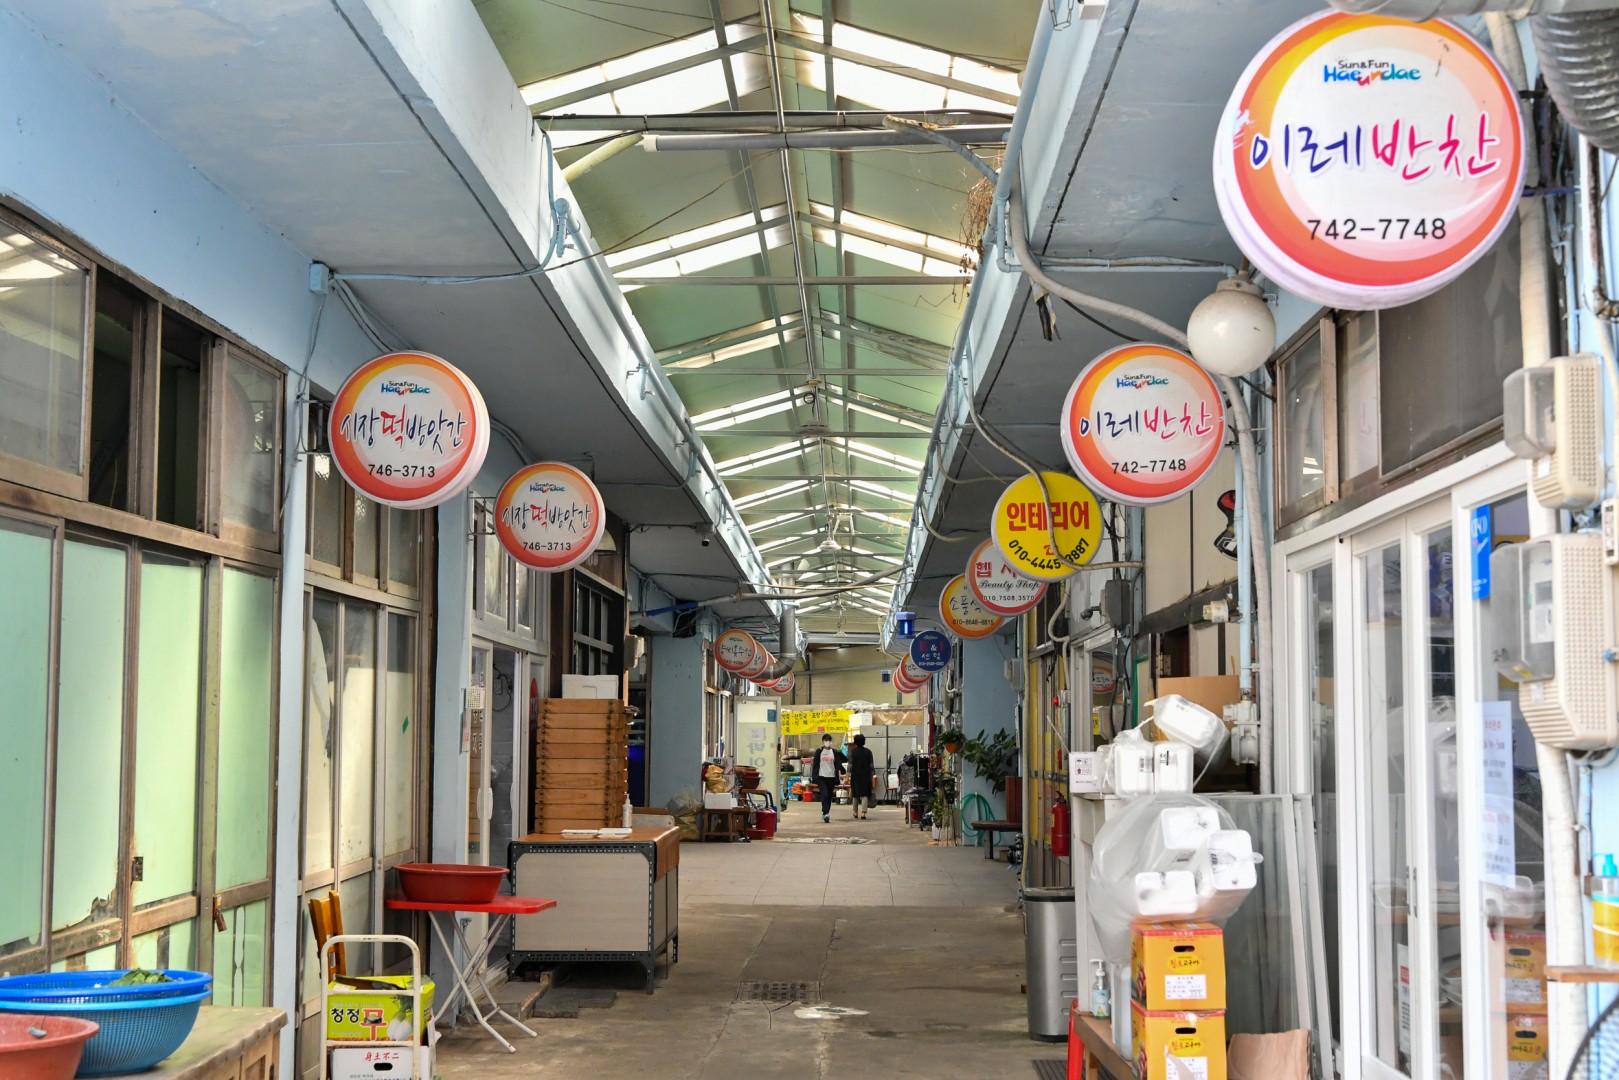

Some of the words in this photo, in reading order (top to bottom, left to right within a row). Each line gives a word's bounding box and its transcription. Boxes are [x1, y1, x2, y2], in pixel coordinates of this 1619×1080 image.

[1338, 59, 1390, 69] Sun&Fun
[1324, 64, 1422, 86] Haeundae
[1252, 114, 1499, 181] 이레반찬
[1307, 218, 1447, 241] 742-7748
[1117, 376, 1169, 389] Haeundae
[1080, 401, 1211, 439] 이레반찬
[368, 464, 435, 478] 746-3713
[1111, 459, 1187, 474] 742-7748
[1006, 501, 1090, 531] 인테리어
[523, 542, 572, 551] 746-3713
[1008, 537, 1090, 570] 010-44453887
[978, 580, 1014, 591] Beauty
[1015, 579, 1040, 591] Shop
[365, 1052, 400, 1062] 身土不二
